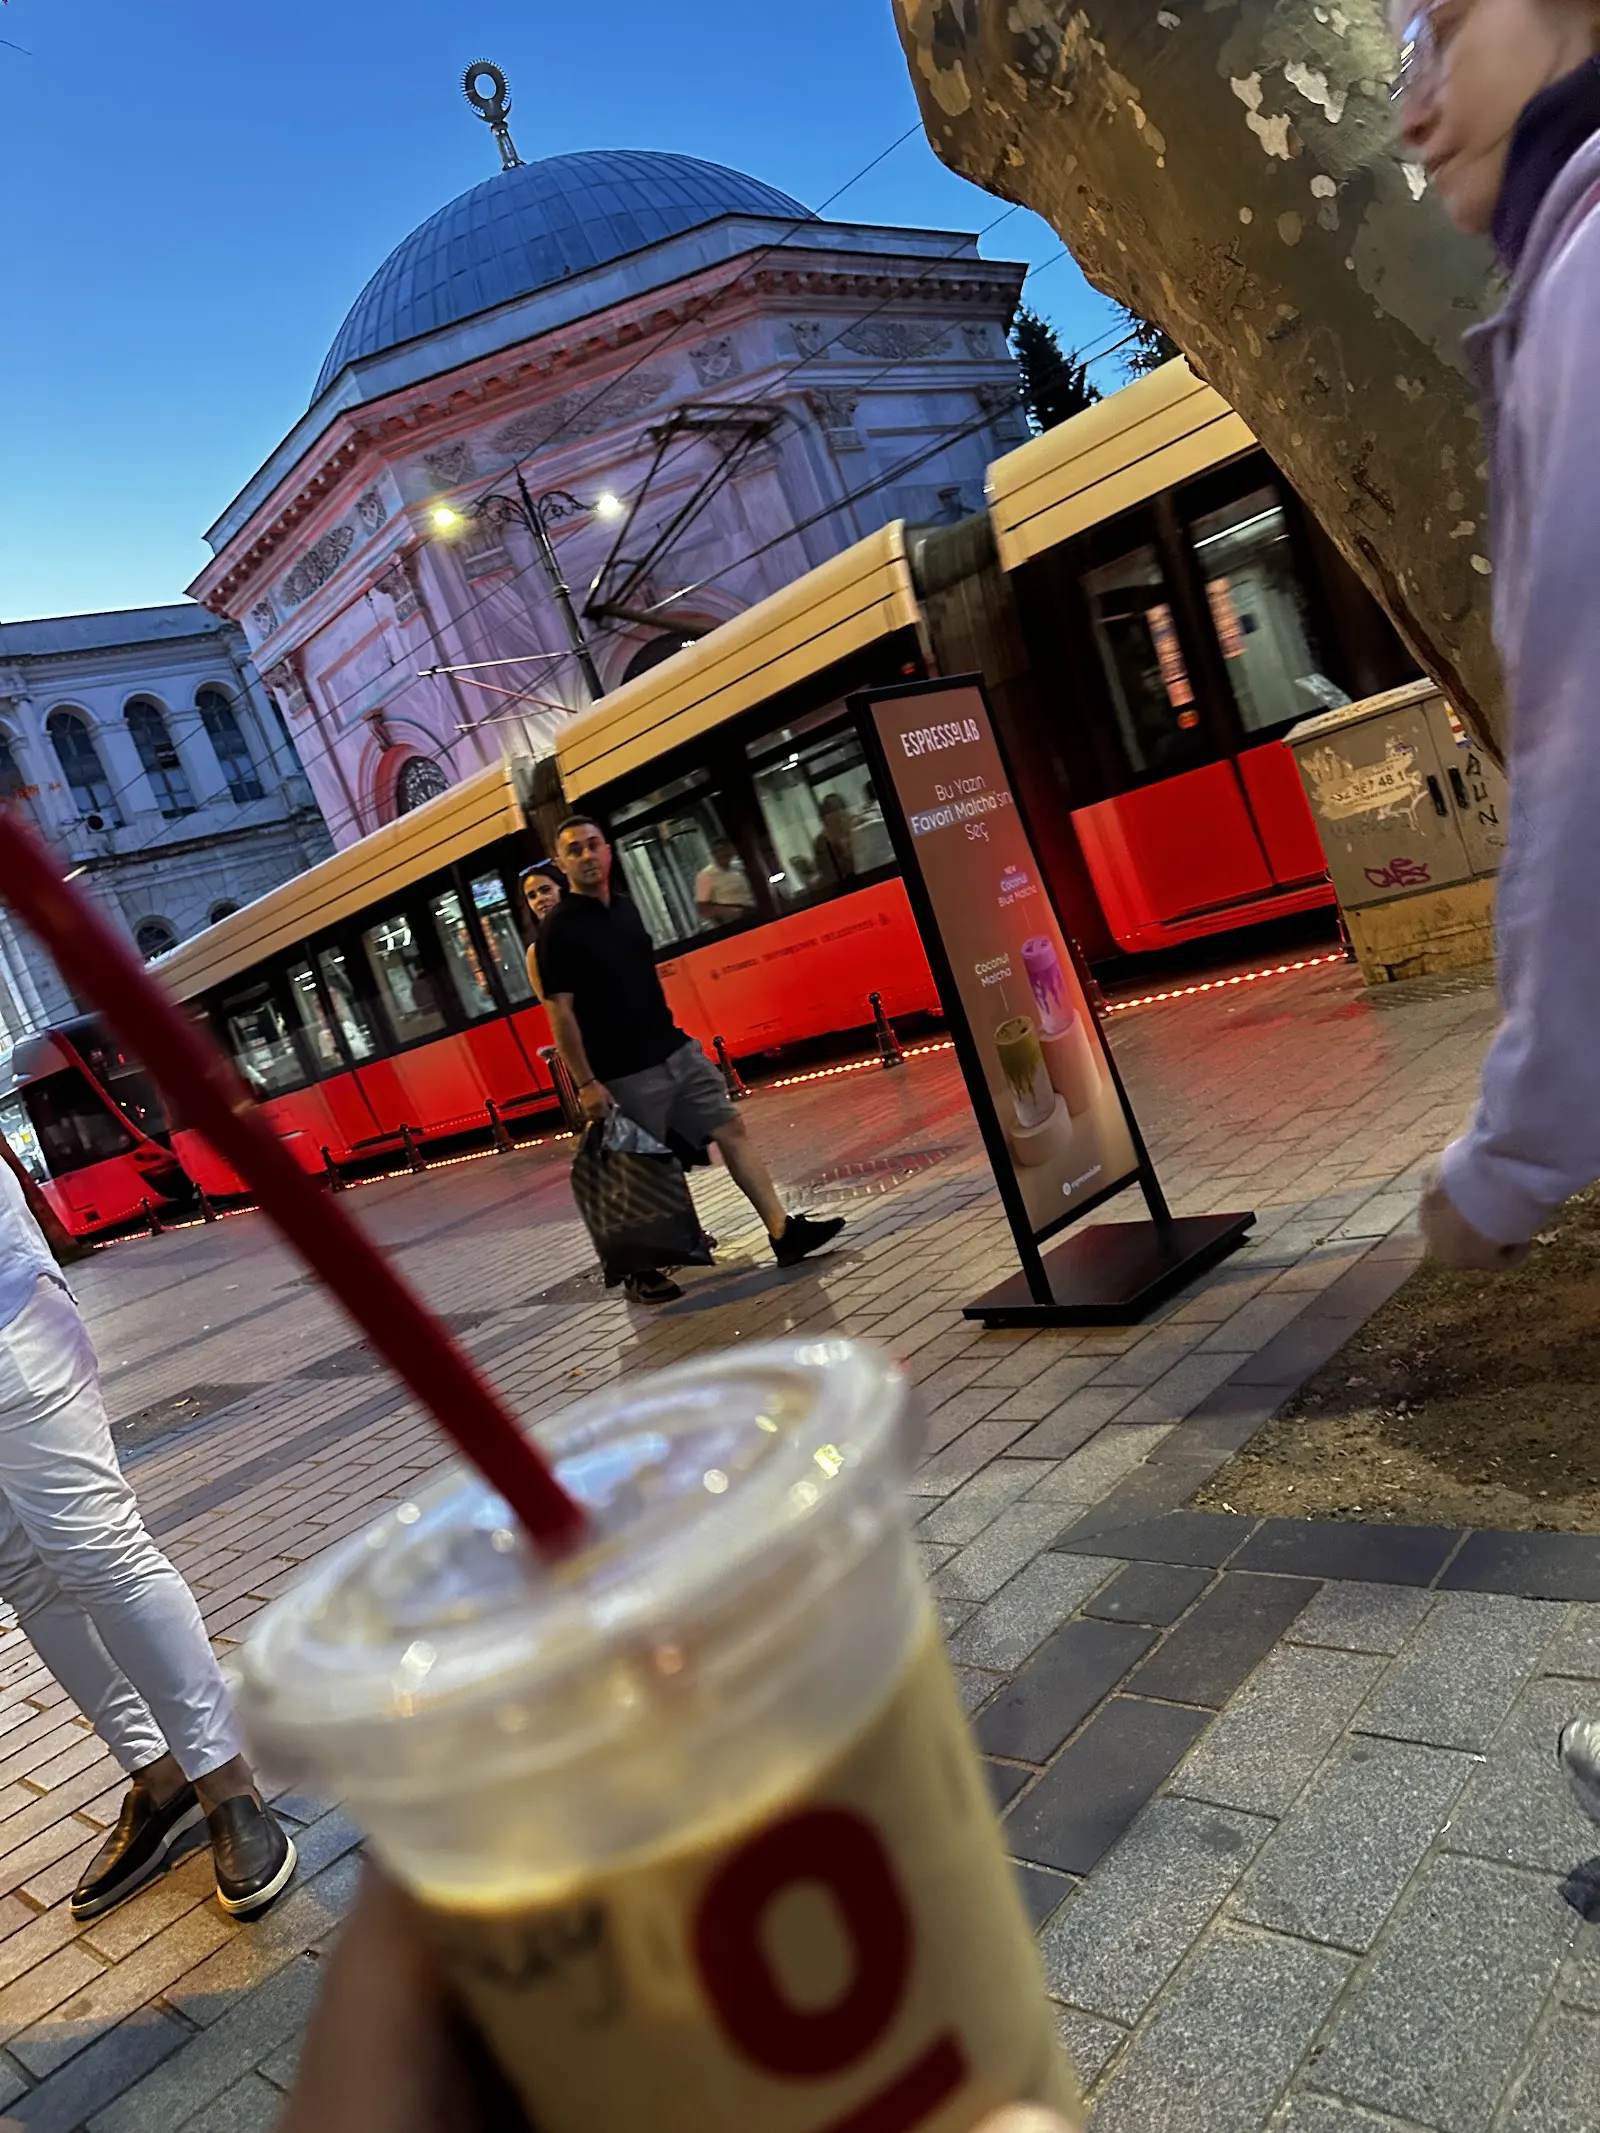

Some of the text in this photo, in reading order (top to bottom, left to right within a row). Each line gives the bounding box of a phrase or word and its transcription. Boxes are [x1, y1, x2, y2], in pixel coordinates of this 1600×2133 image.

[934, 775, 986, 801] Bu Yazın
[910, 805, 954, 834] Favori
[1000, 872, 1028, 892] Coconut
[997, 884, 1038, 908] Blue Matcha
[974, 951, 1010, 975] Coconut
[980, 967, 1012, 988] Matcha
